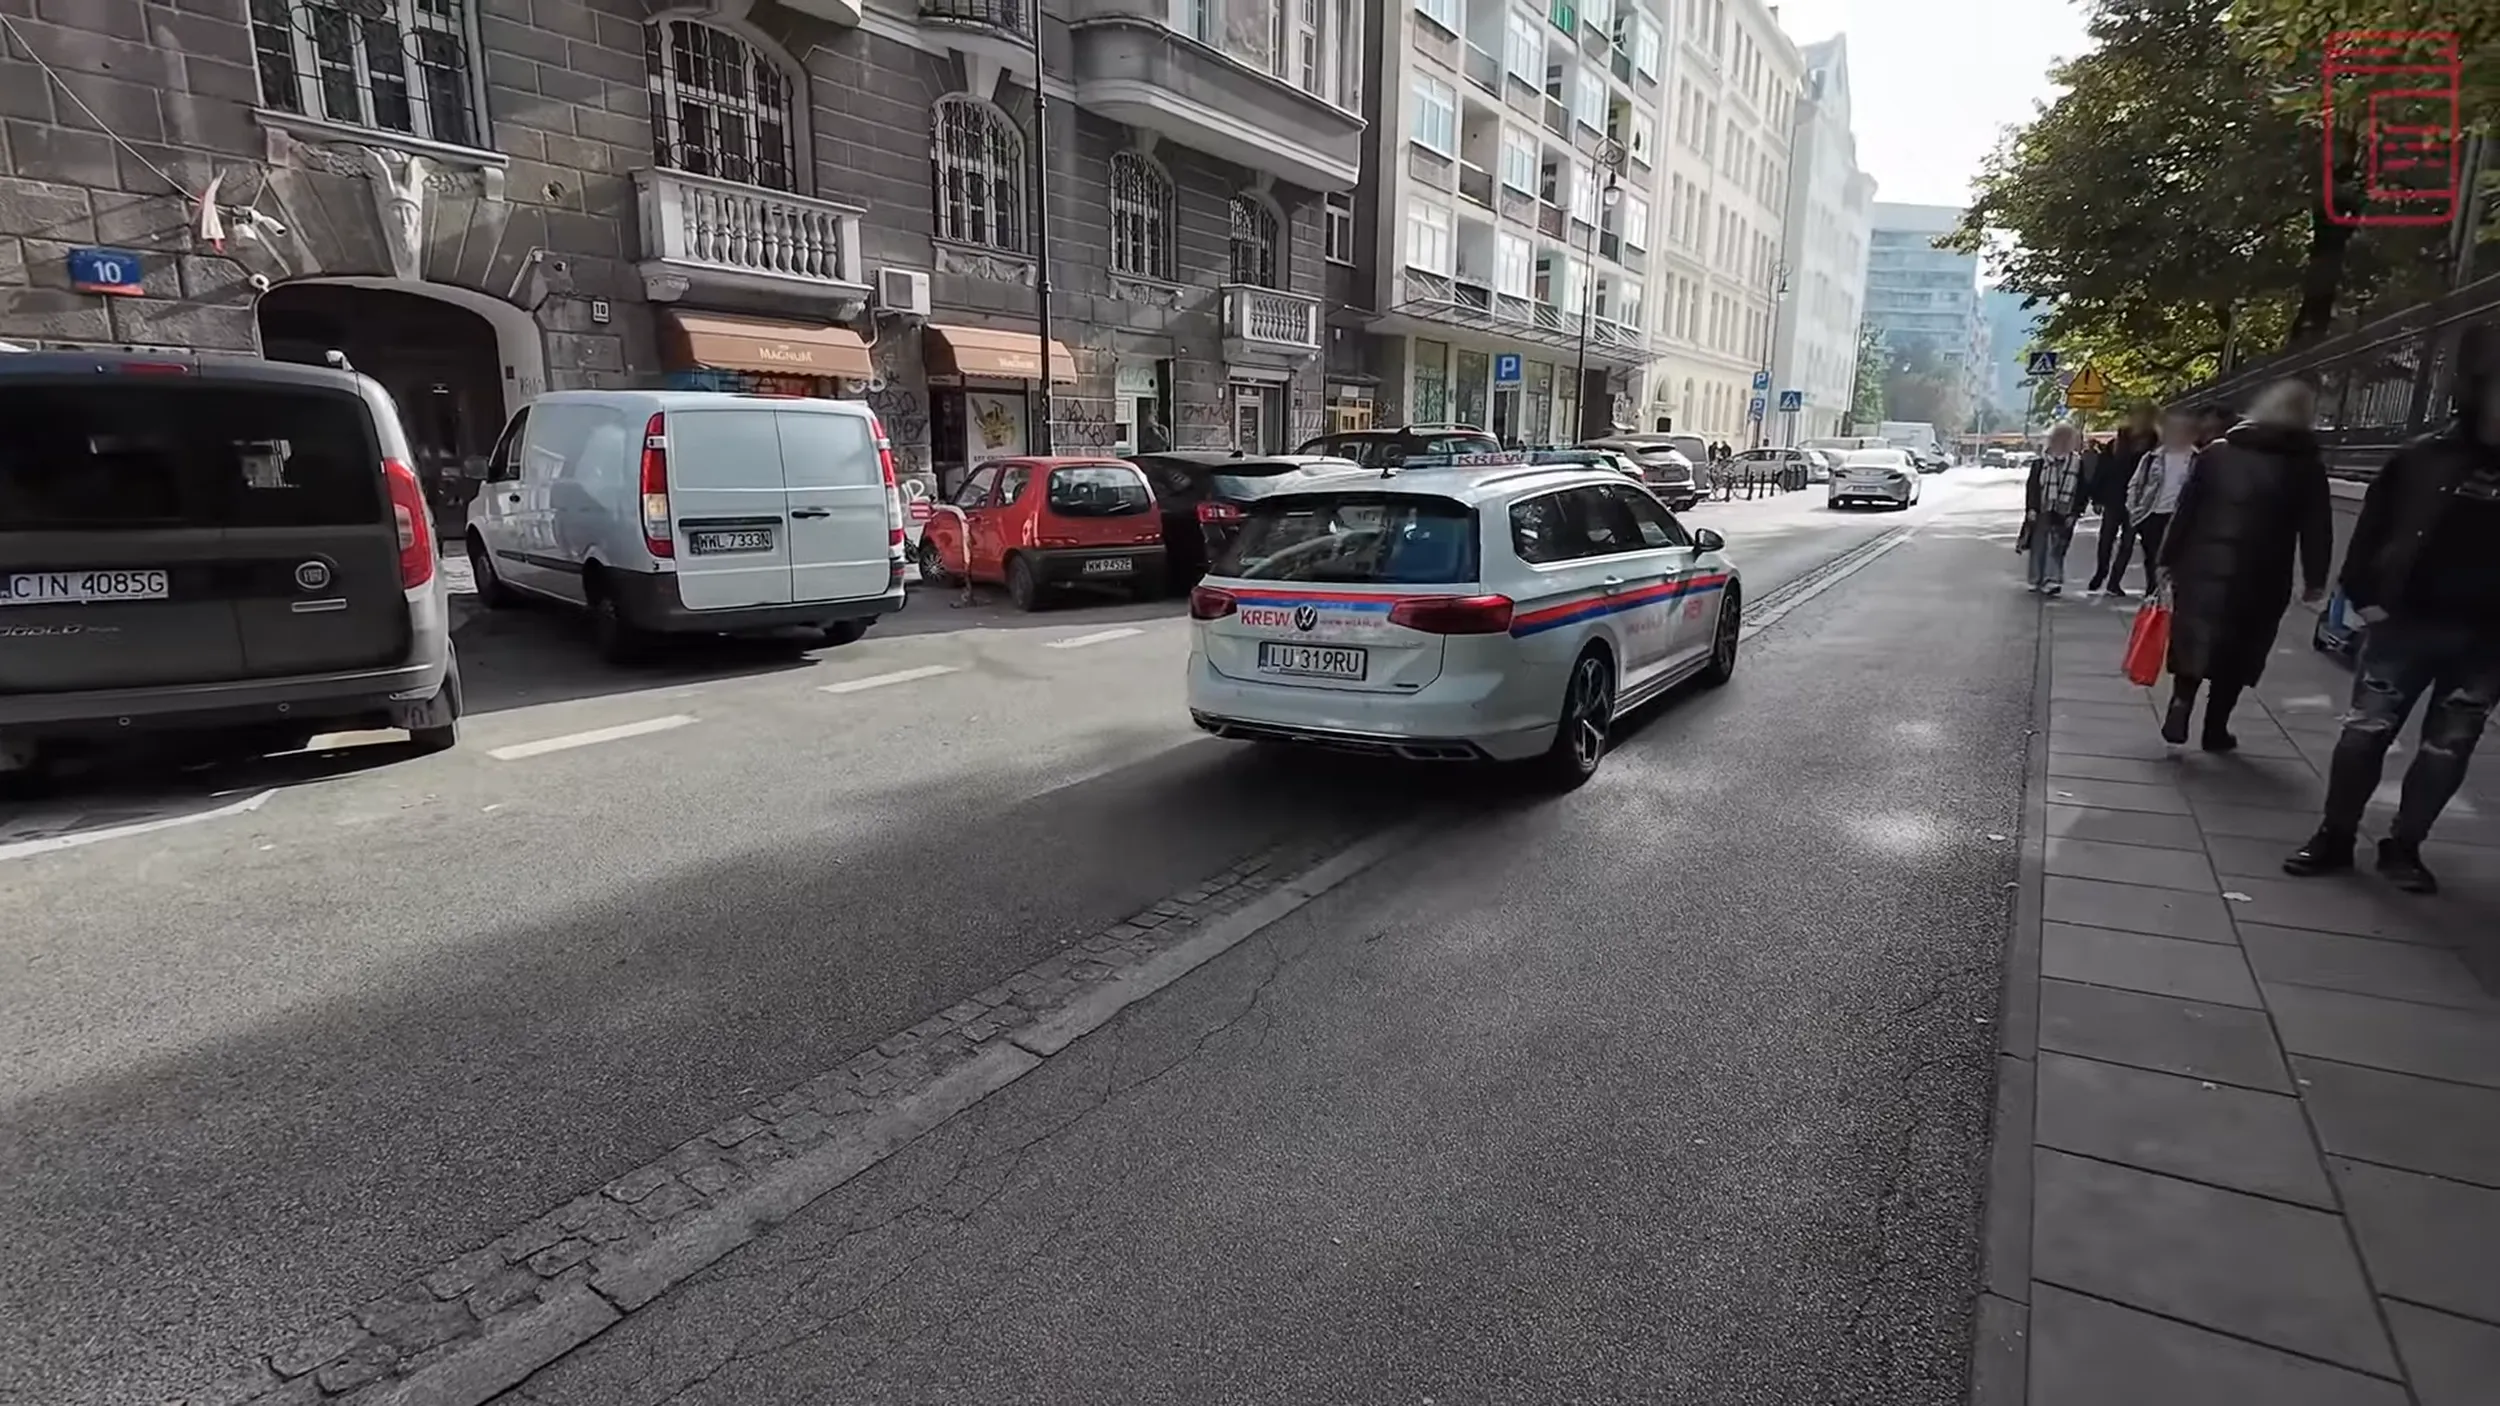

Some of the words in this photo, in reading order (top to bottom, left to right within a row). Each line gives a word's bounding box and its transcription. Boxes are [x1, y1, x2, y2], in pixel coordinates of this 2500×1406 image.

[93, 261, 121, 283] 10
[595, 303, 607, 315] 10
[1501, 357, 1516, 377] P
[1756, 373, 1766, 384] P
[1457, 454, 1524, 466] KREW
[14, 575, 68, 598] CIN
[81, 572, 165, 595] 4085G
[1241, 610, 1290, 626] KREW
[1271, 646, 1294, 668] LU
[1300, 650, 1359, 673] 319RU
